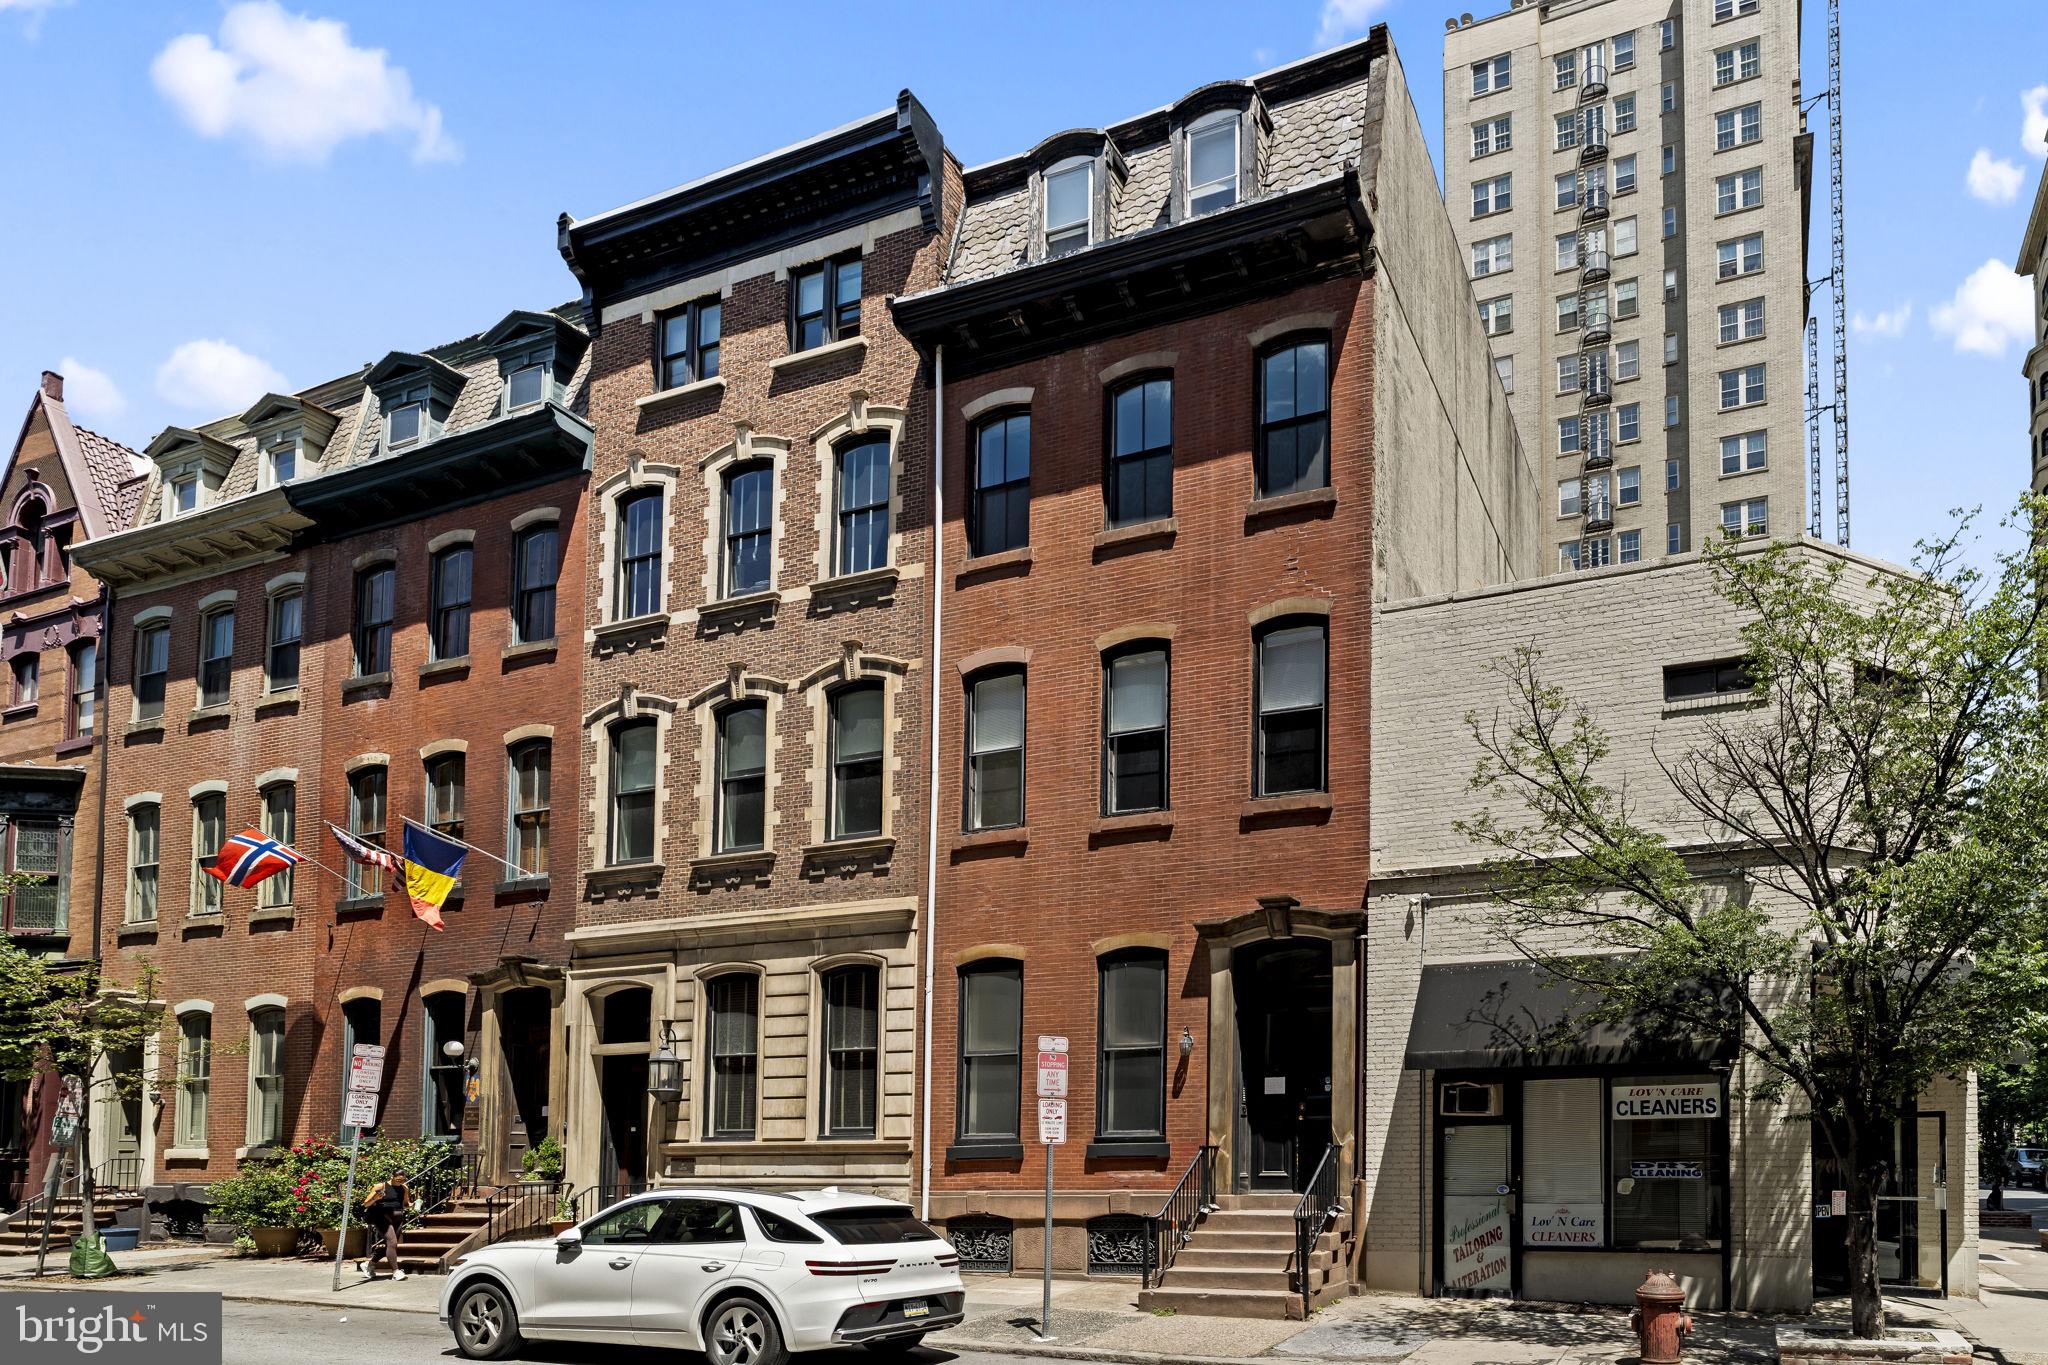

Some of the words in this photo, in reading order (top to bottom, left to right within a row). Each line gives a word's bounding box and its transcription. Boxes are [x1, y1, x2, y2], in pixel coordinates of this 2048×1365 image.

[1670, 1087, 1704, 1096] CARE
[1616, 1098, 1717, 1116] CLEANERS
[1632, 1169, 1702, 1177] CLEANING
[1450, 1199, 1500, 1243] Professional
[1557, 1217, 1567, 1227] N
[1571, 1217, 1596, 1227] Care
[1532, 1232, 1595, 1243] CLEANERS
[1453, 1226, 1503, 1263] TAILORING
[1477, 1253, 1485, 1264] &
